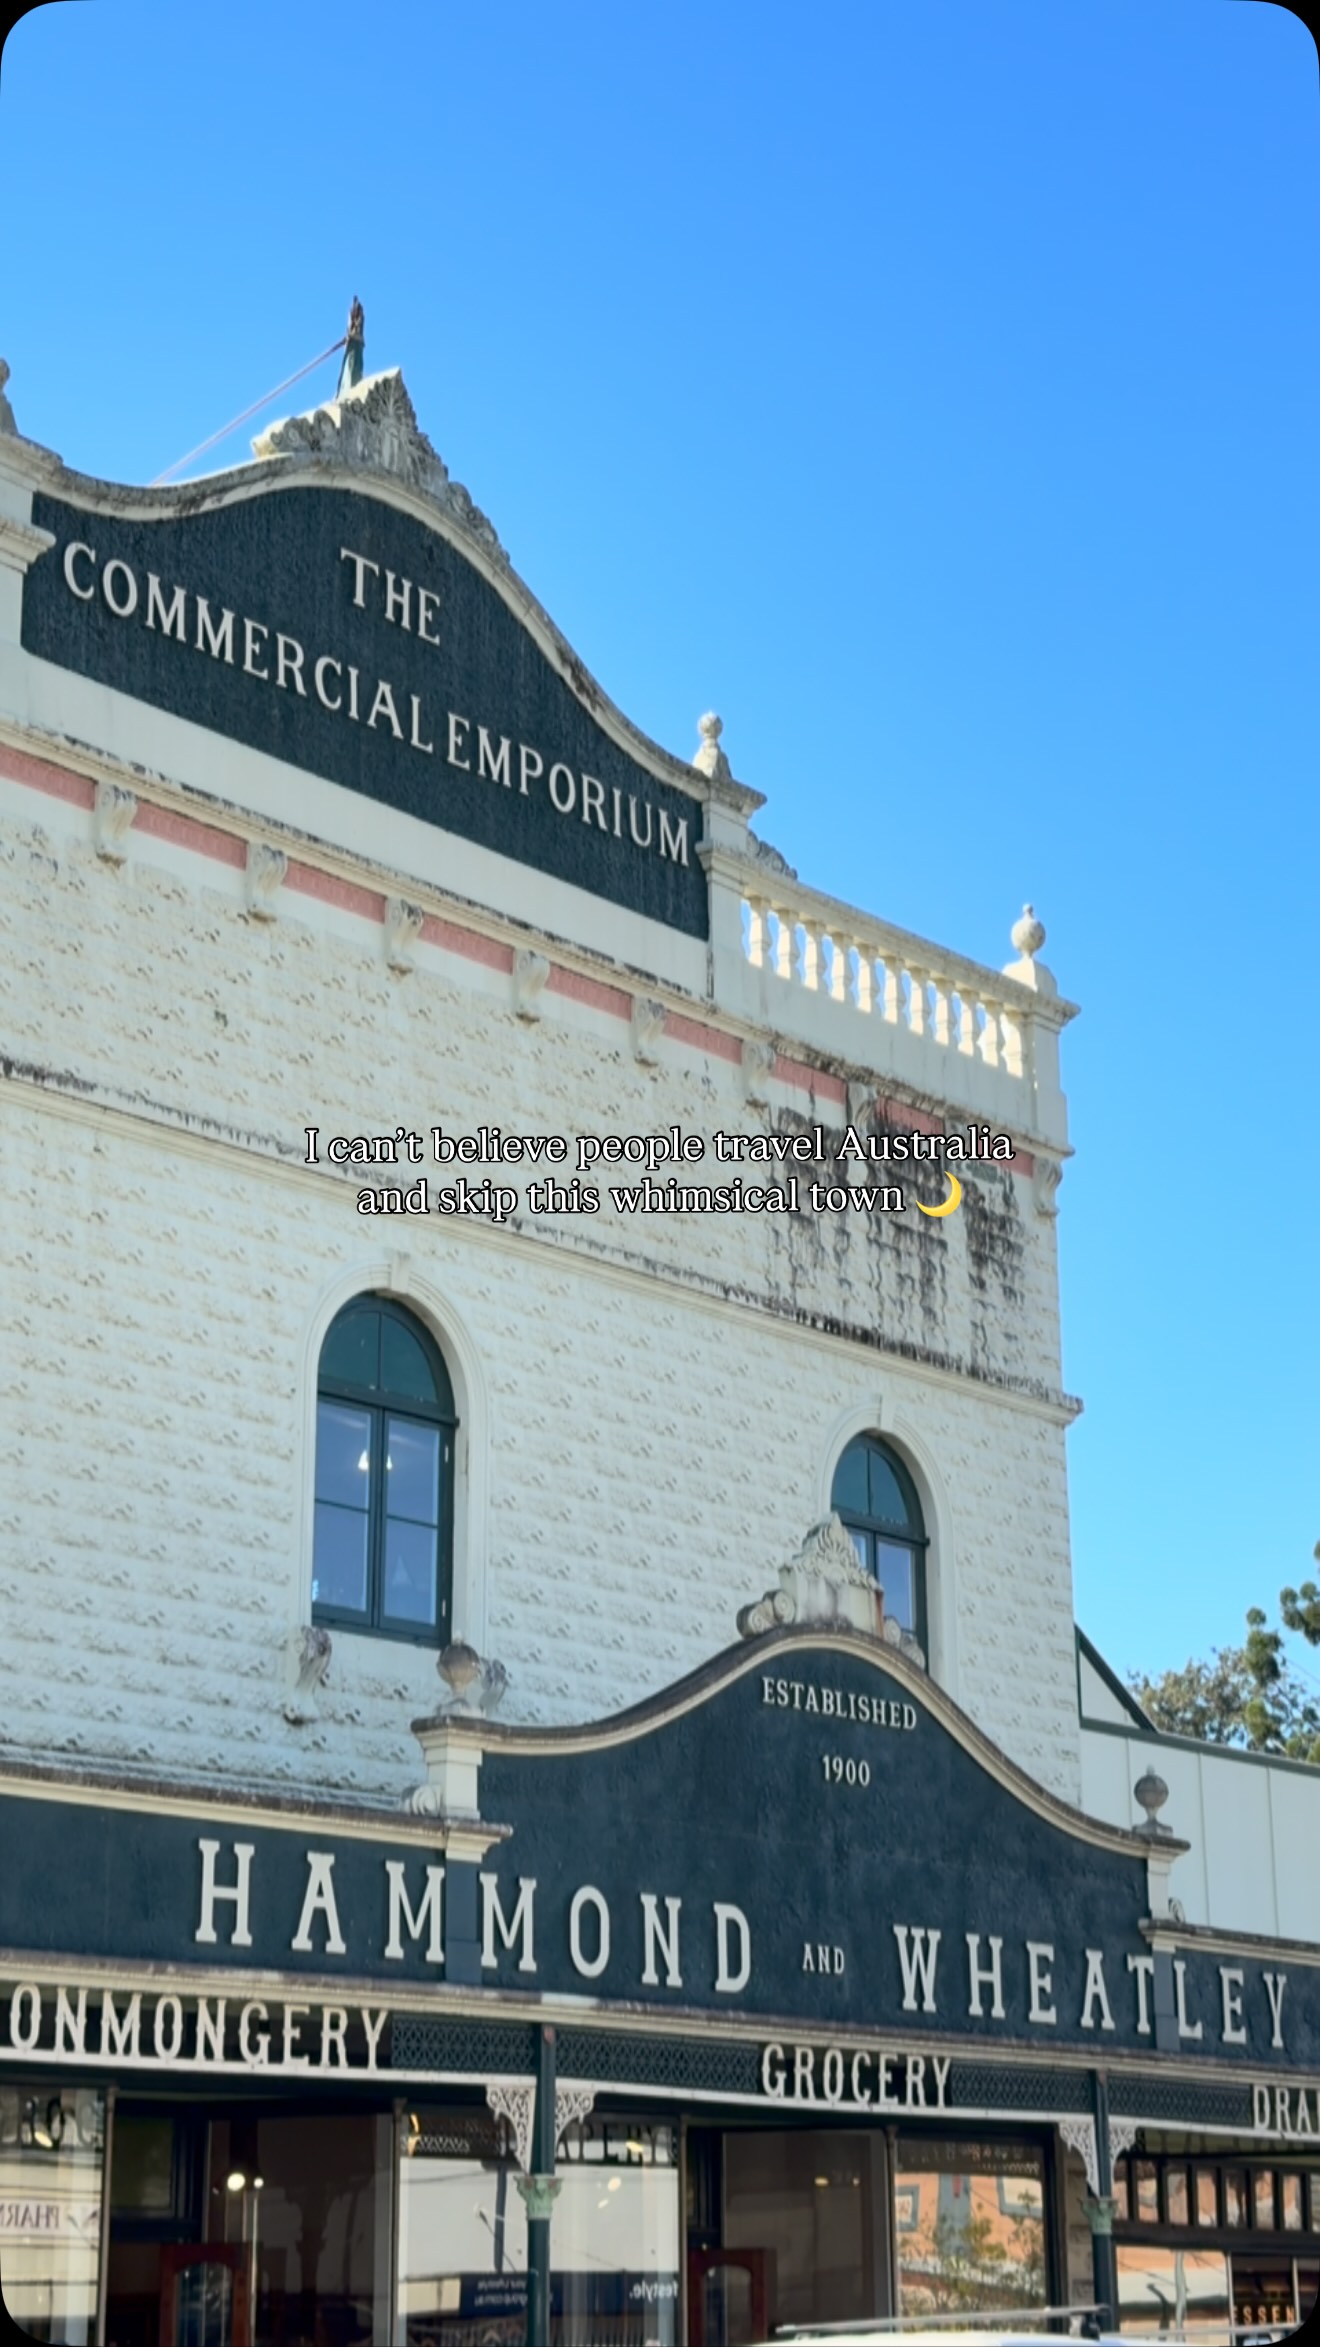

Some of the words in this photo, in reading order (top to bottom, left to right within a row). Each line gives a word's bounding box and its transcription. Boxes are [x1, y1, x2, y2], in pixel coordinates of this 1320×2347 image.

[340, 547, 441, 646] THE
[62, 541, 434, 753] COMMERCIAL
[446, 711, 690, 867] EMPORIUM
[762, 1677, 917, 1731] ESTABLISHED
[822, 1755, 871, 1788] 1900
[195, 1838, 752, 1993] HAMMOND
[802, 1943, 846, 1976] AND
[893, 1924, 1287, 2049] WHEATLEY
[10, 1982, 389, 2070] ONMONGERY
[761, 2042, 952, 2109] GROCERY
[1253, 2085, 1320, 2133] DRA
